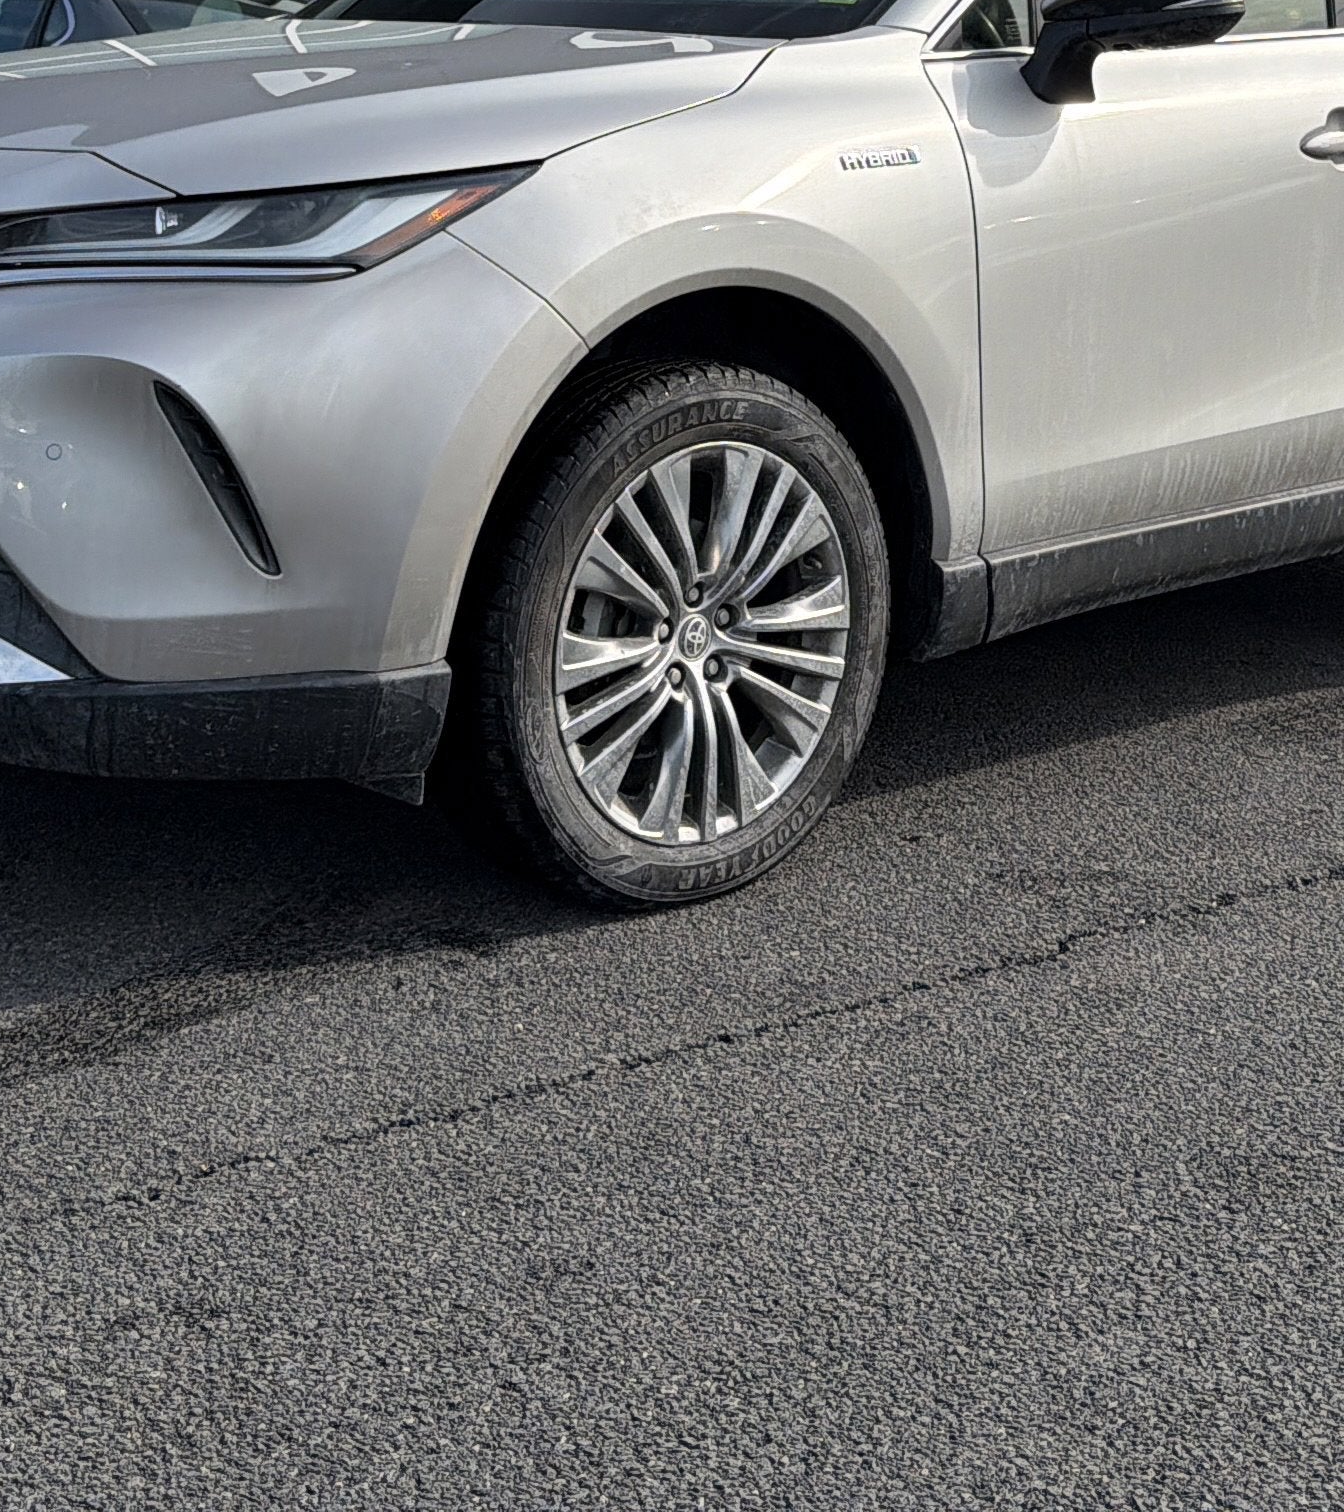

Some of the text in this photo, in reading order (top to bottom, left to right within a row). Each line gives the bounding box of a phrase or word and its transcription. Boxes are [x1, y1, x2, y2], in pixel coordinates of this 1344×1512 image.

[839, 147, 912, 170] HYBRID
[612, 400, 750, 473] ASSURANCE
[677, 794, 817, 890] GOODYEAR
